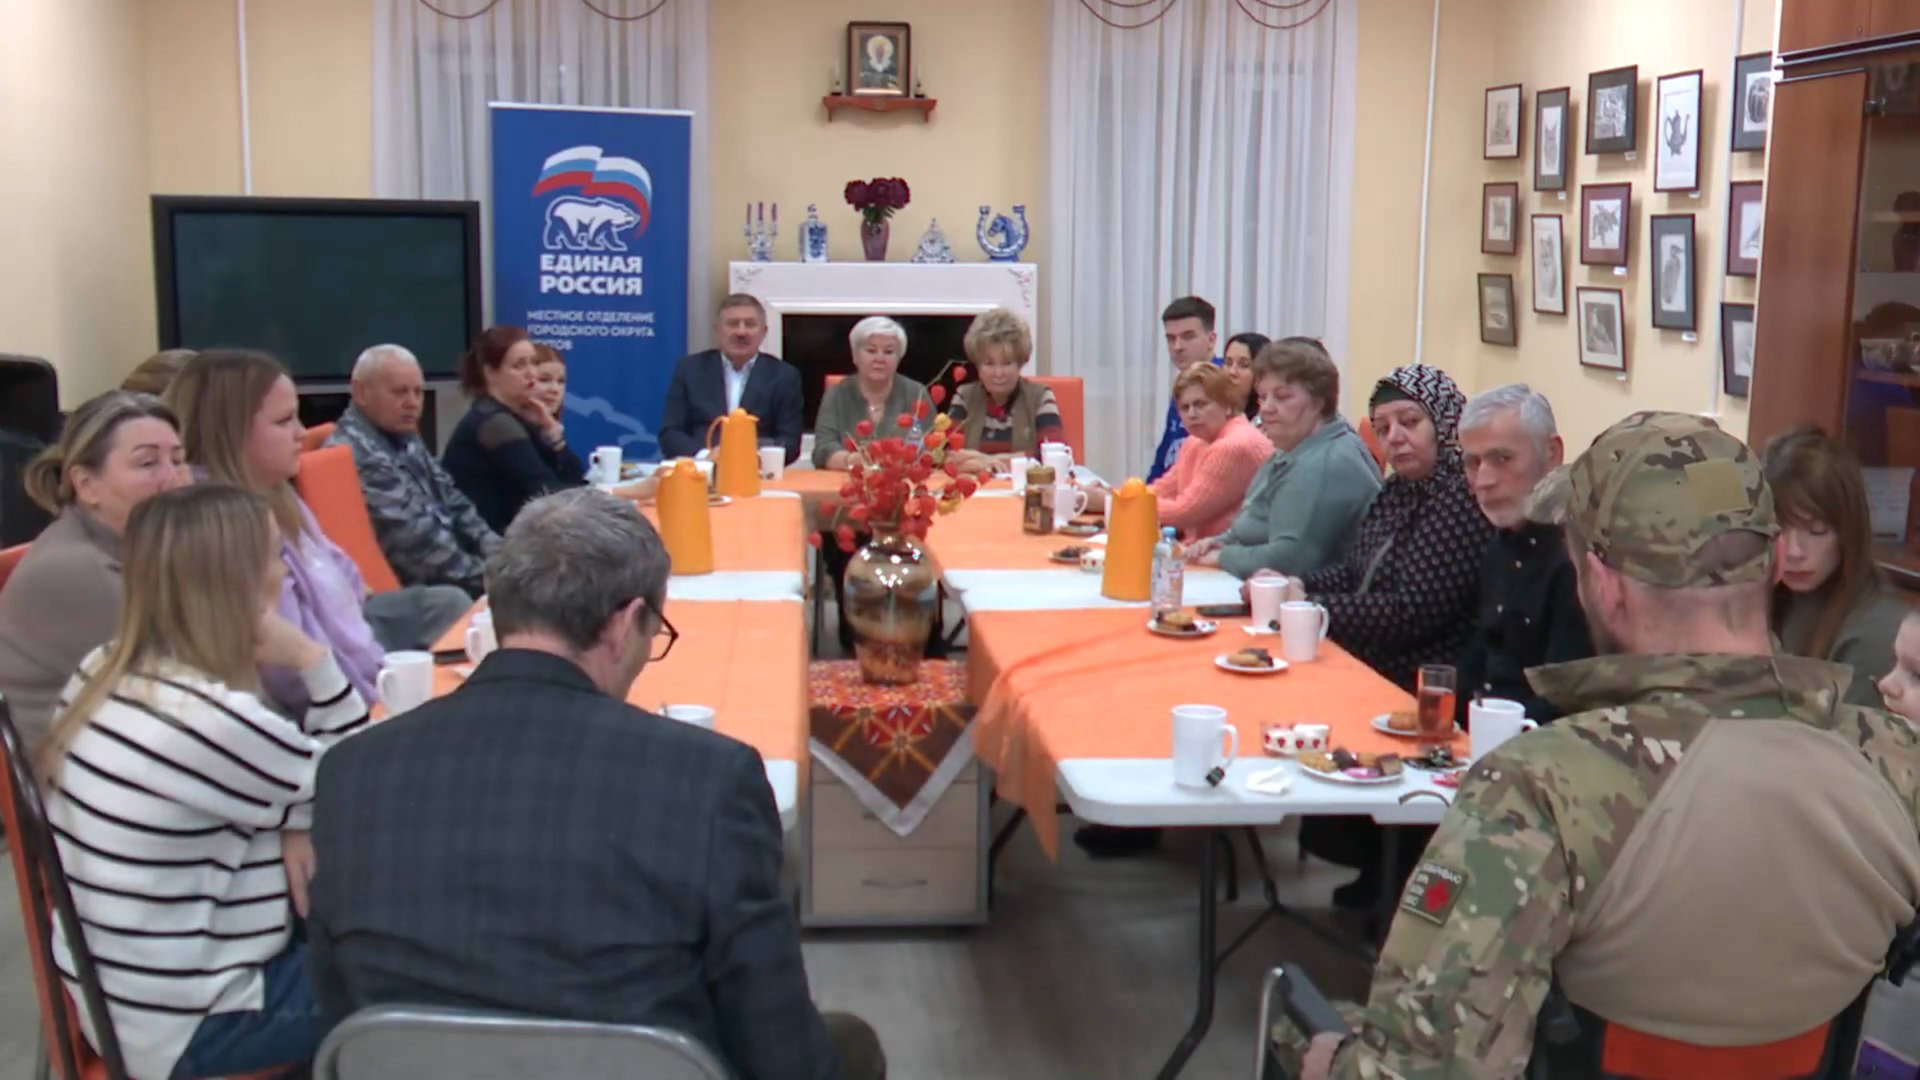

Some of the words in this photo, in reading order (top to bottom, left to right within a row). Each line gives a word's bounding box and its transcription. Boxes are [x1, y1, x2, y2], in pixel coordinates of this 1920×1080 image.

[541, 254, 643, 274] ЕДИНАЯ
[541, 274, 643, 296] РОССИЯ
[527, 310, 584, 321] МЕСТНОЕ
[586, 311, 654, 323] ОТДЕЛЕНИЕ
[527, 324, 609, 336] ГОРОДСКОГО
[611, 326, 654, 337] ОКРУГА
